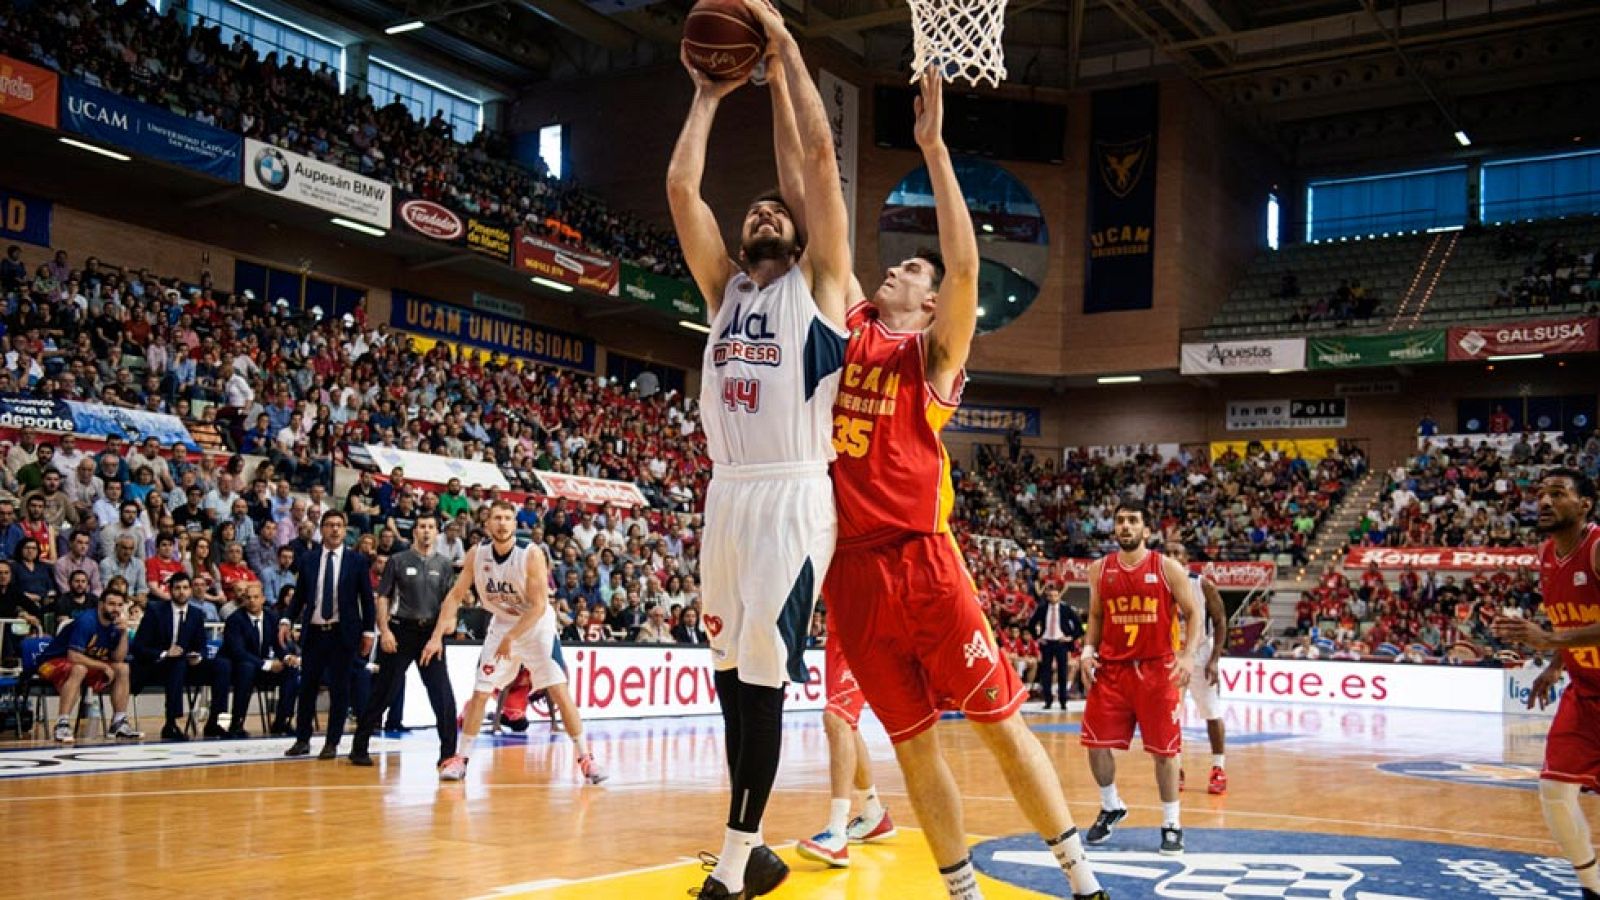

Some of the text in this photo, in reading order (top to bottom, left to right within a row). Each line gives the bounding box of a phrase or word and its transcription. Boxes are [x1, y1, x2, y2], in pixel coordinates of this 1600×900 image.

[68, 96, 128, 130] UCAM
[294, 161, 351, 191] Aupesán
[353, 180, 386, 201] BMW
[0, 197, 26, 232] D
[1090, 225, 1151, 248] UCAM
[406, 299, 461, 335] UCAM
[469, 313, 584, 364] UNIVERSIDAD
[1496, 323, 1585, 344] GALSUSA
[1207, 343, 1272, 366] Apuestas
[723, 378, 760, 413] 44
[1, 412, 74, 432] deporte
[833, 415, 873, 458] 35
[1124, 624, 1139, 647] 7
[1221, 652, 1388, 701] vitae.es
